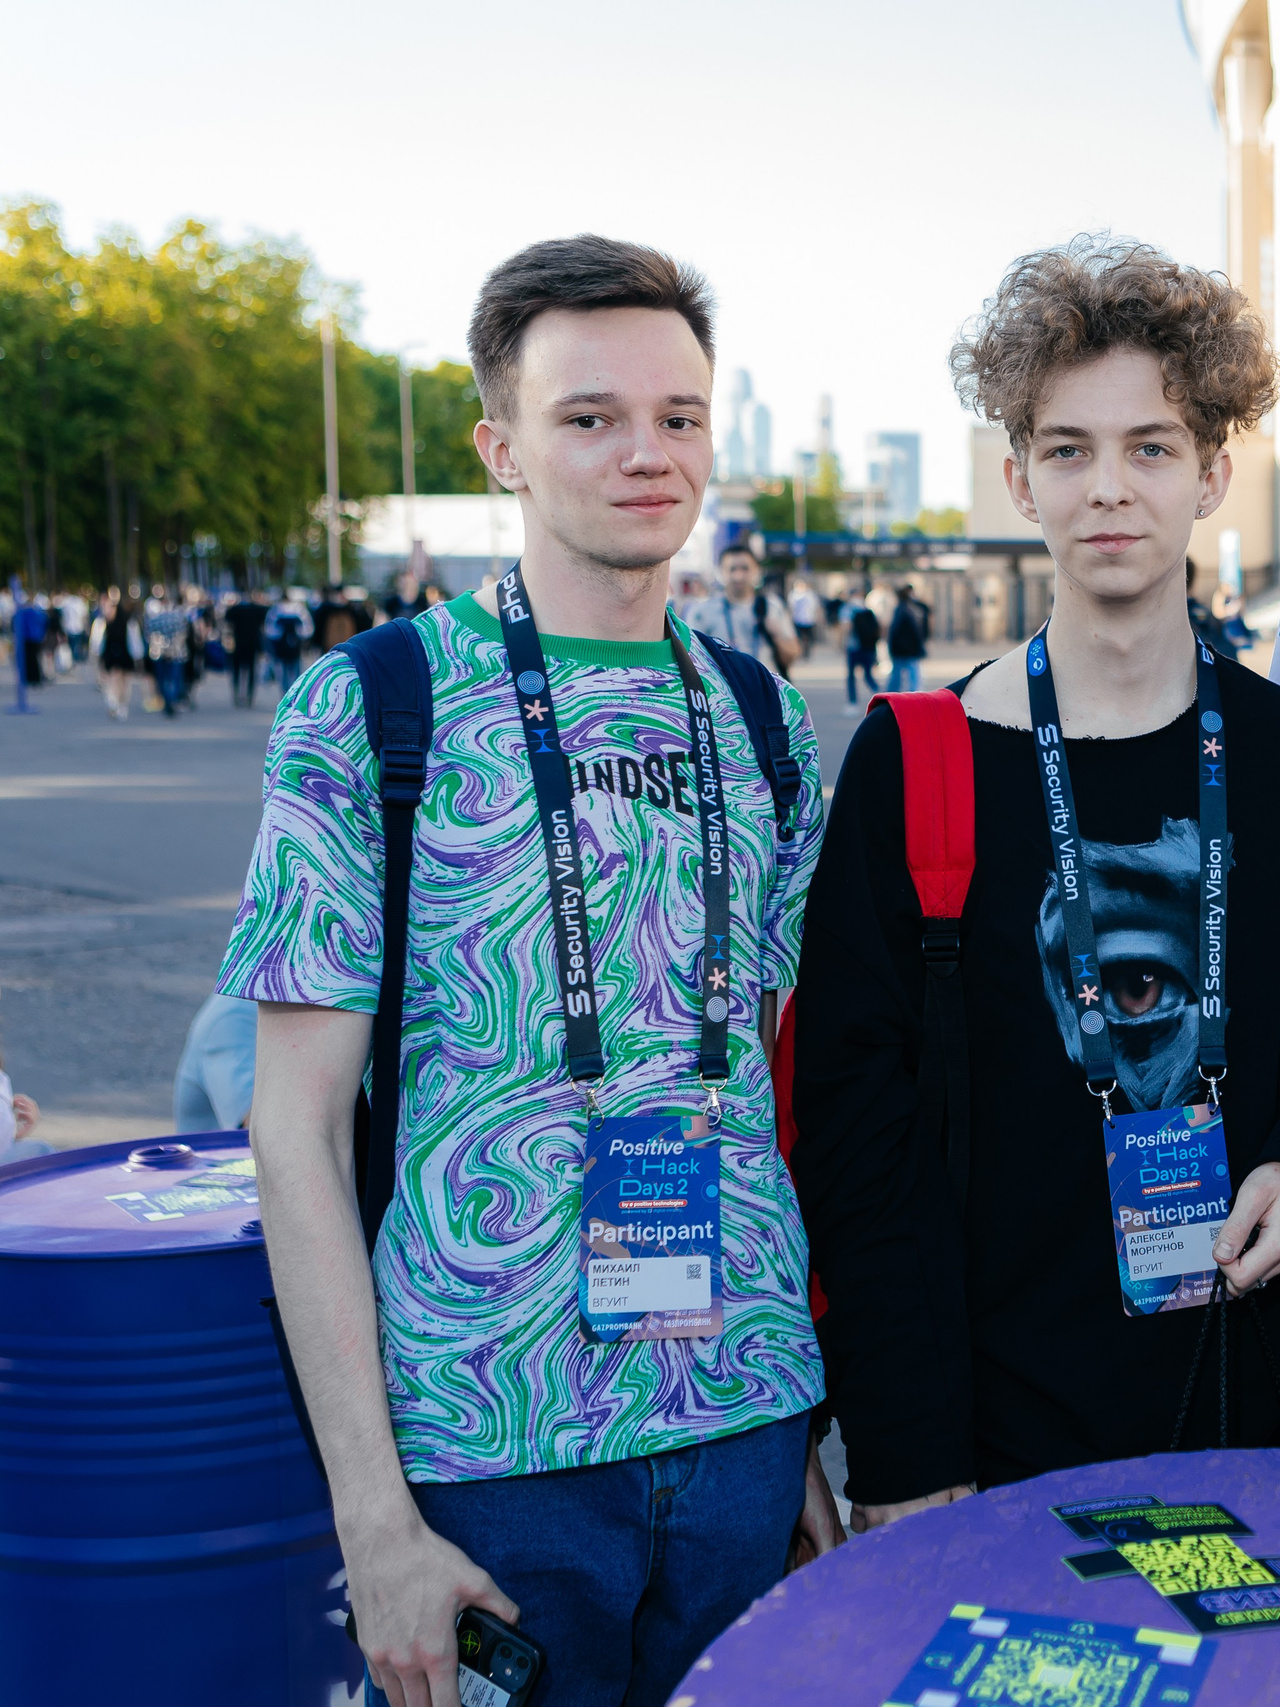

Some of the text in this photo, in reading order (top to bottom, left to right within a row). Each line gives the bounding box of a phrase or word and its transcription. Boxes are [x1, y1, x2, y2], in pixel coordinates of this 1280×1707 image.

[563, 751, 696, 817] INDSE
[695, 716, 723, 876] Security Vision
[1042, 749, 1080, 901] Security Vision
[551, 809, 587, 988] Security Vision
[1205, 838, 1226, 991] Security Vision
[608, 1138, 685, 1157] Positive
[1125, 1128, 1192, 1150] Positive
[1156, 1142, 1209, 1164] Hack
[642, 1158, 700, 1176] Hack
[1139, 1162, 1201, 1185] Days 2
[619, 1179, 688, 1199] Days 2
[1119, 1196, 1228, 1228] Participant
[588, 1220, 714, 1247] Participant
[1129, 1229, 1175, 1246] АЛЕКСЕЙ
[1130, 1241, 1185, 1257] МОРГУНОВ
[592, 1263, 641, 1274] МИХАИЛ
[1133, 1261, 1164, 1275] ВГУИТ
[592, 1276, 630, 1288] ЛЕТИН
[592, 1296, 629, 1308] ВГУИТ
[1133, 1292, 1177, 1307] GAZPROMBANK
[592, 1322, 643, 1332] GAZPROMBANK
